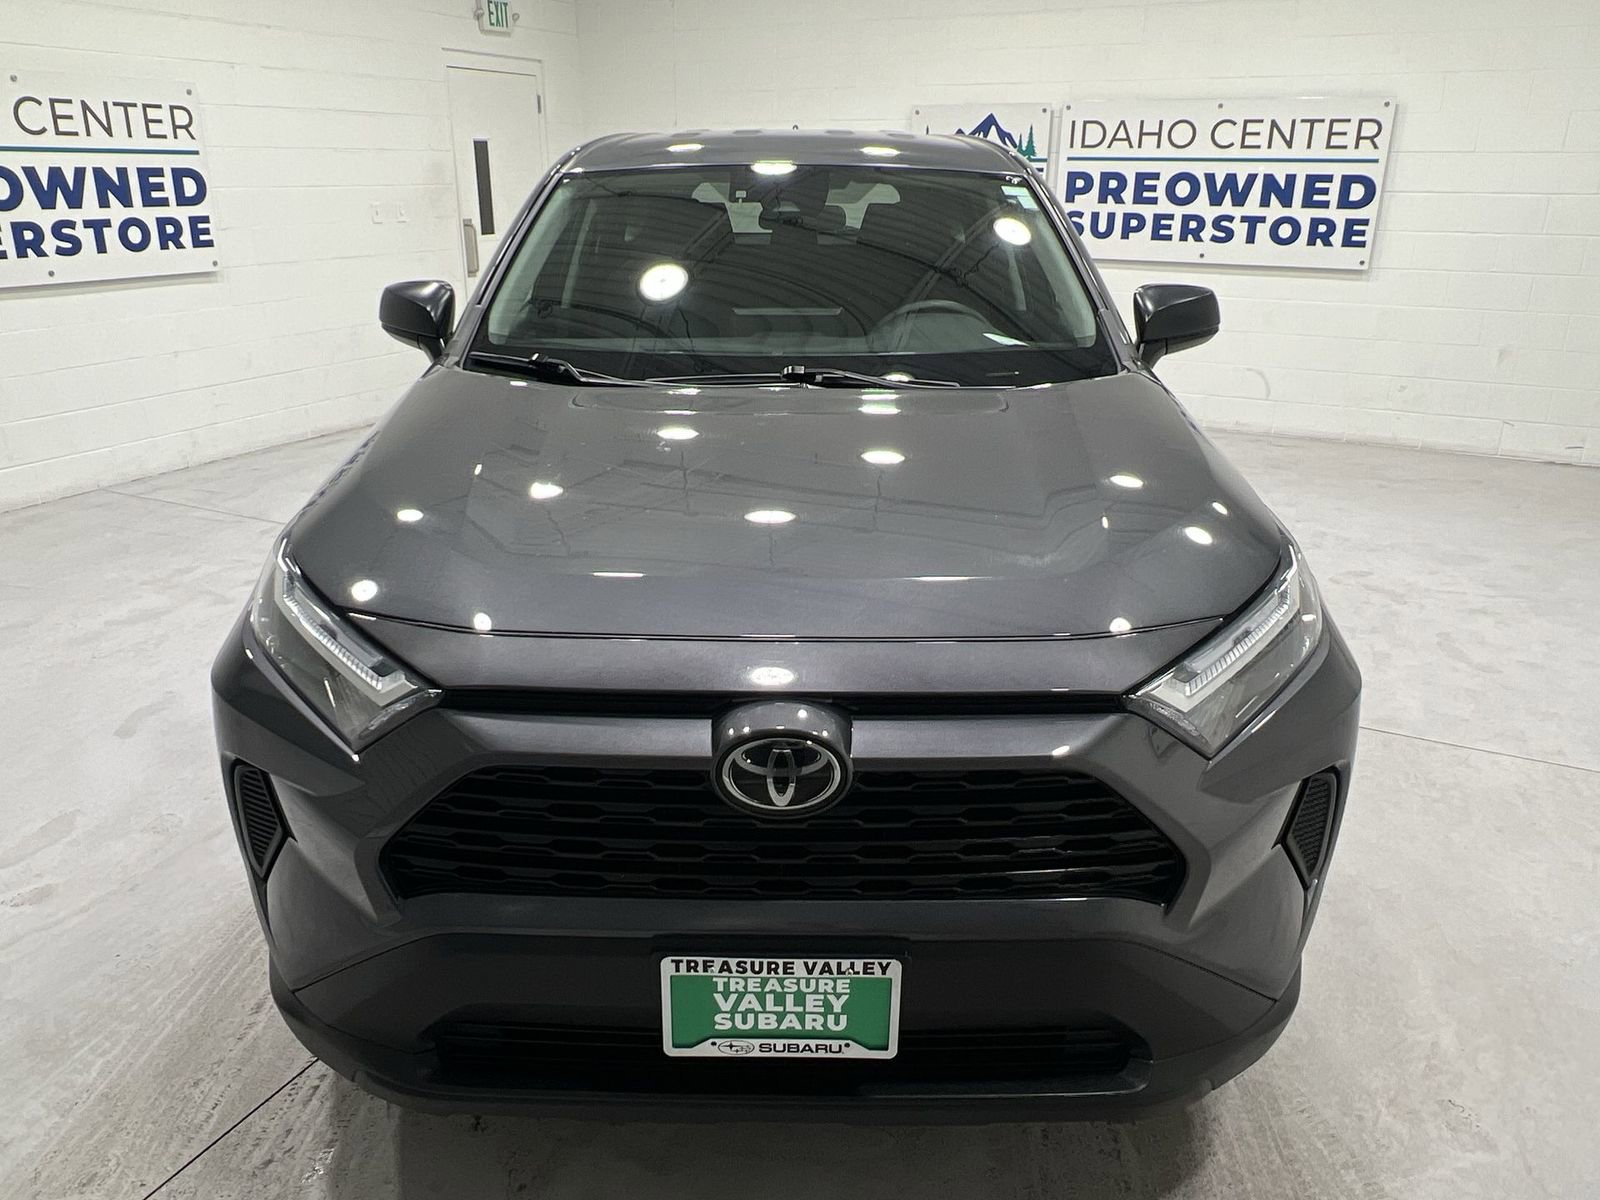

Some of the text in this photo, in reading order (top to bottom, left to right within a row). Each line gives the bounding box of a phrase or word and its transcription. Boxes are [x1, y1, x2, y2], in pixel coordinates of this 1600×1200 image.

[487, 0, 508, 28] EXIT
[13, 96, 196, 140] CENTER
[1068, 118, 1384, 151] IDAHO CENTER
[1064, 171, 1378, 210] PREOWNED
[0, 215, 215, 259] RSTORE
[1066, 211, 1370, 247] SUPERSTORE
[671, 959, 891, 976] TREASURE VALLEY
[712, 977, 850, 993] TREASURE
[713, 993, 849, 1012] VALLEY
[714, 1013, 848, 1031] SUBARU
[758, 1043, 843, 1054] SUBARU
